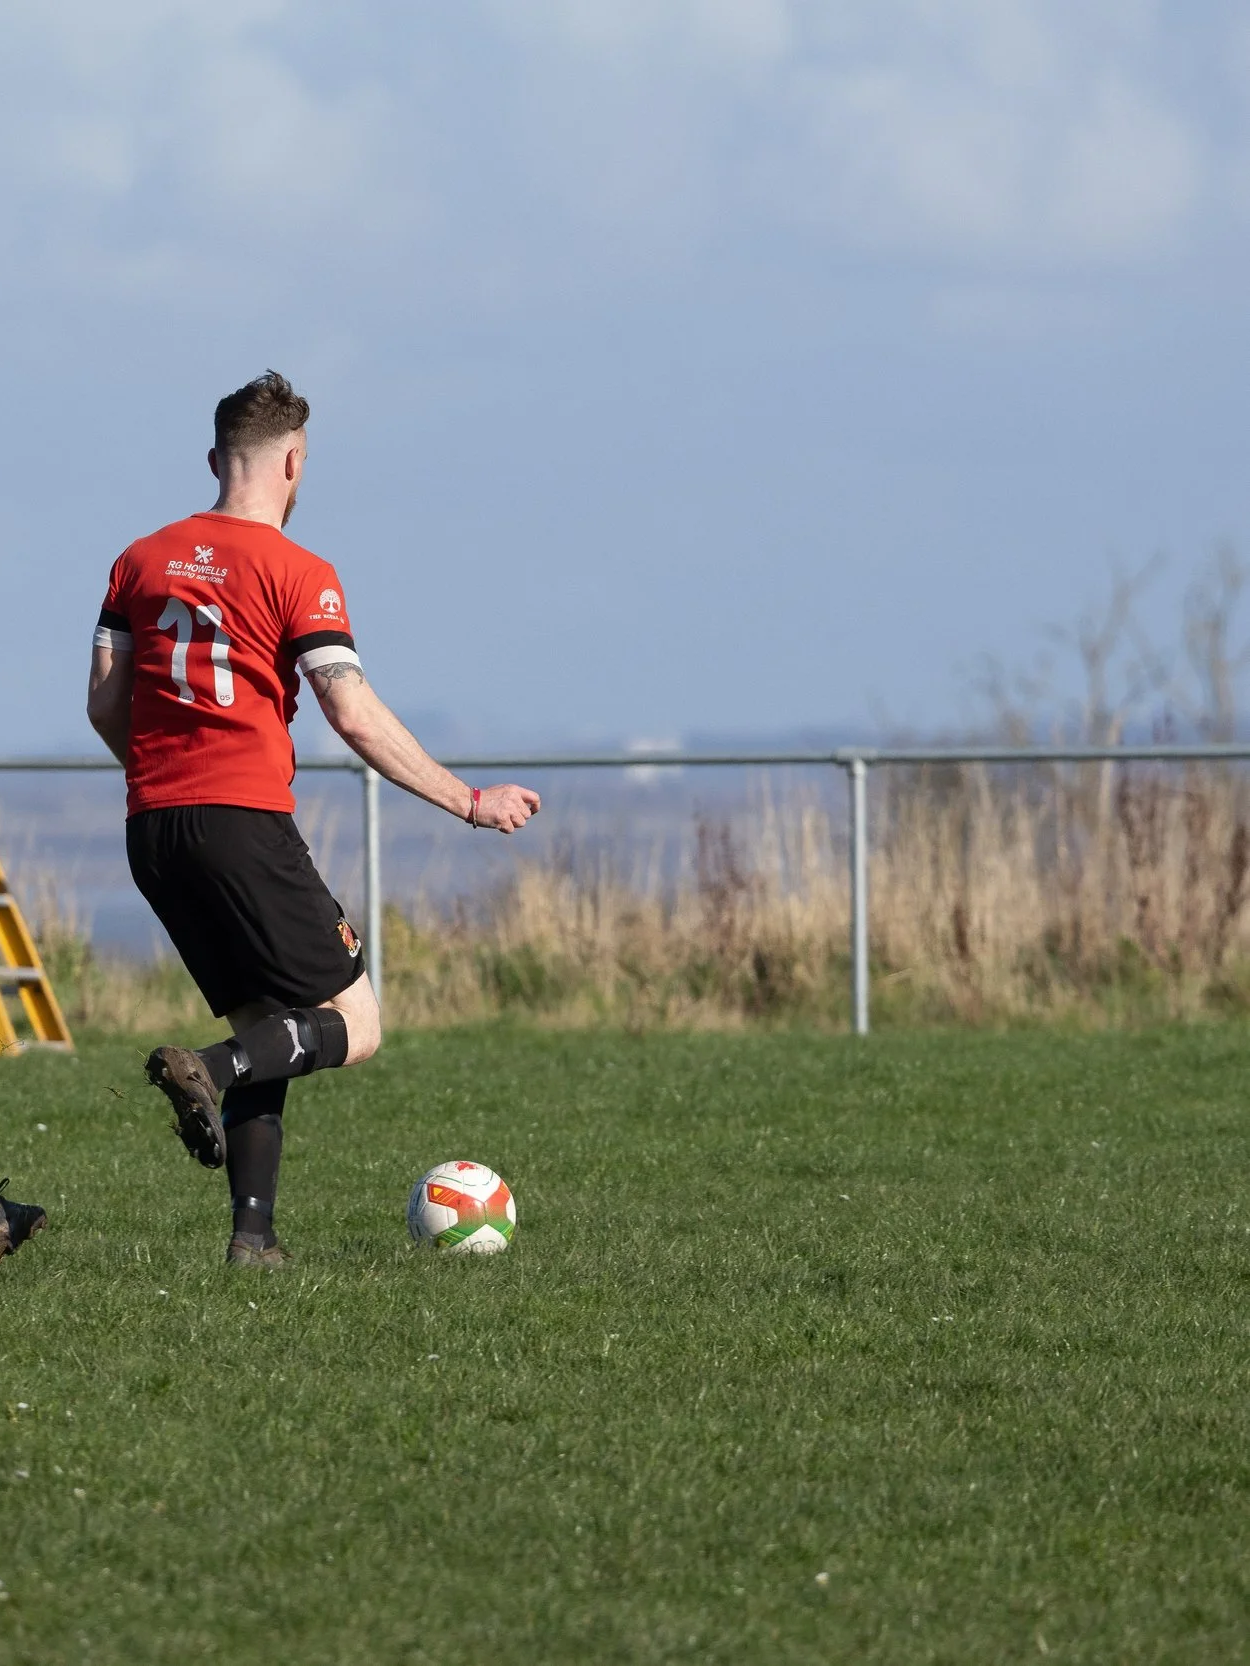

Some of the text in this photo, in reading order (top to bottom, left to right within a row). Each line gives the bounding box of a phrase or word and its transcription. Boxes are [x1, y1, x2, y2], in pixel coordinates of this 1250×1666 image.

[165, 568, 225, 585] cleaning services
[167, 560, 228, 577] RG HOWELLS
[157, 597, 234, 707] 11
